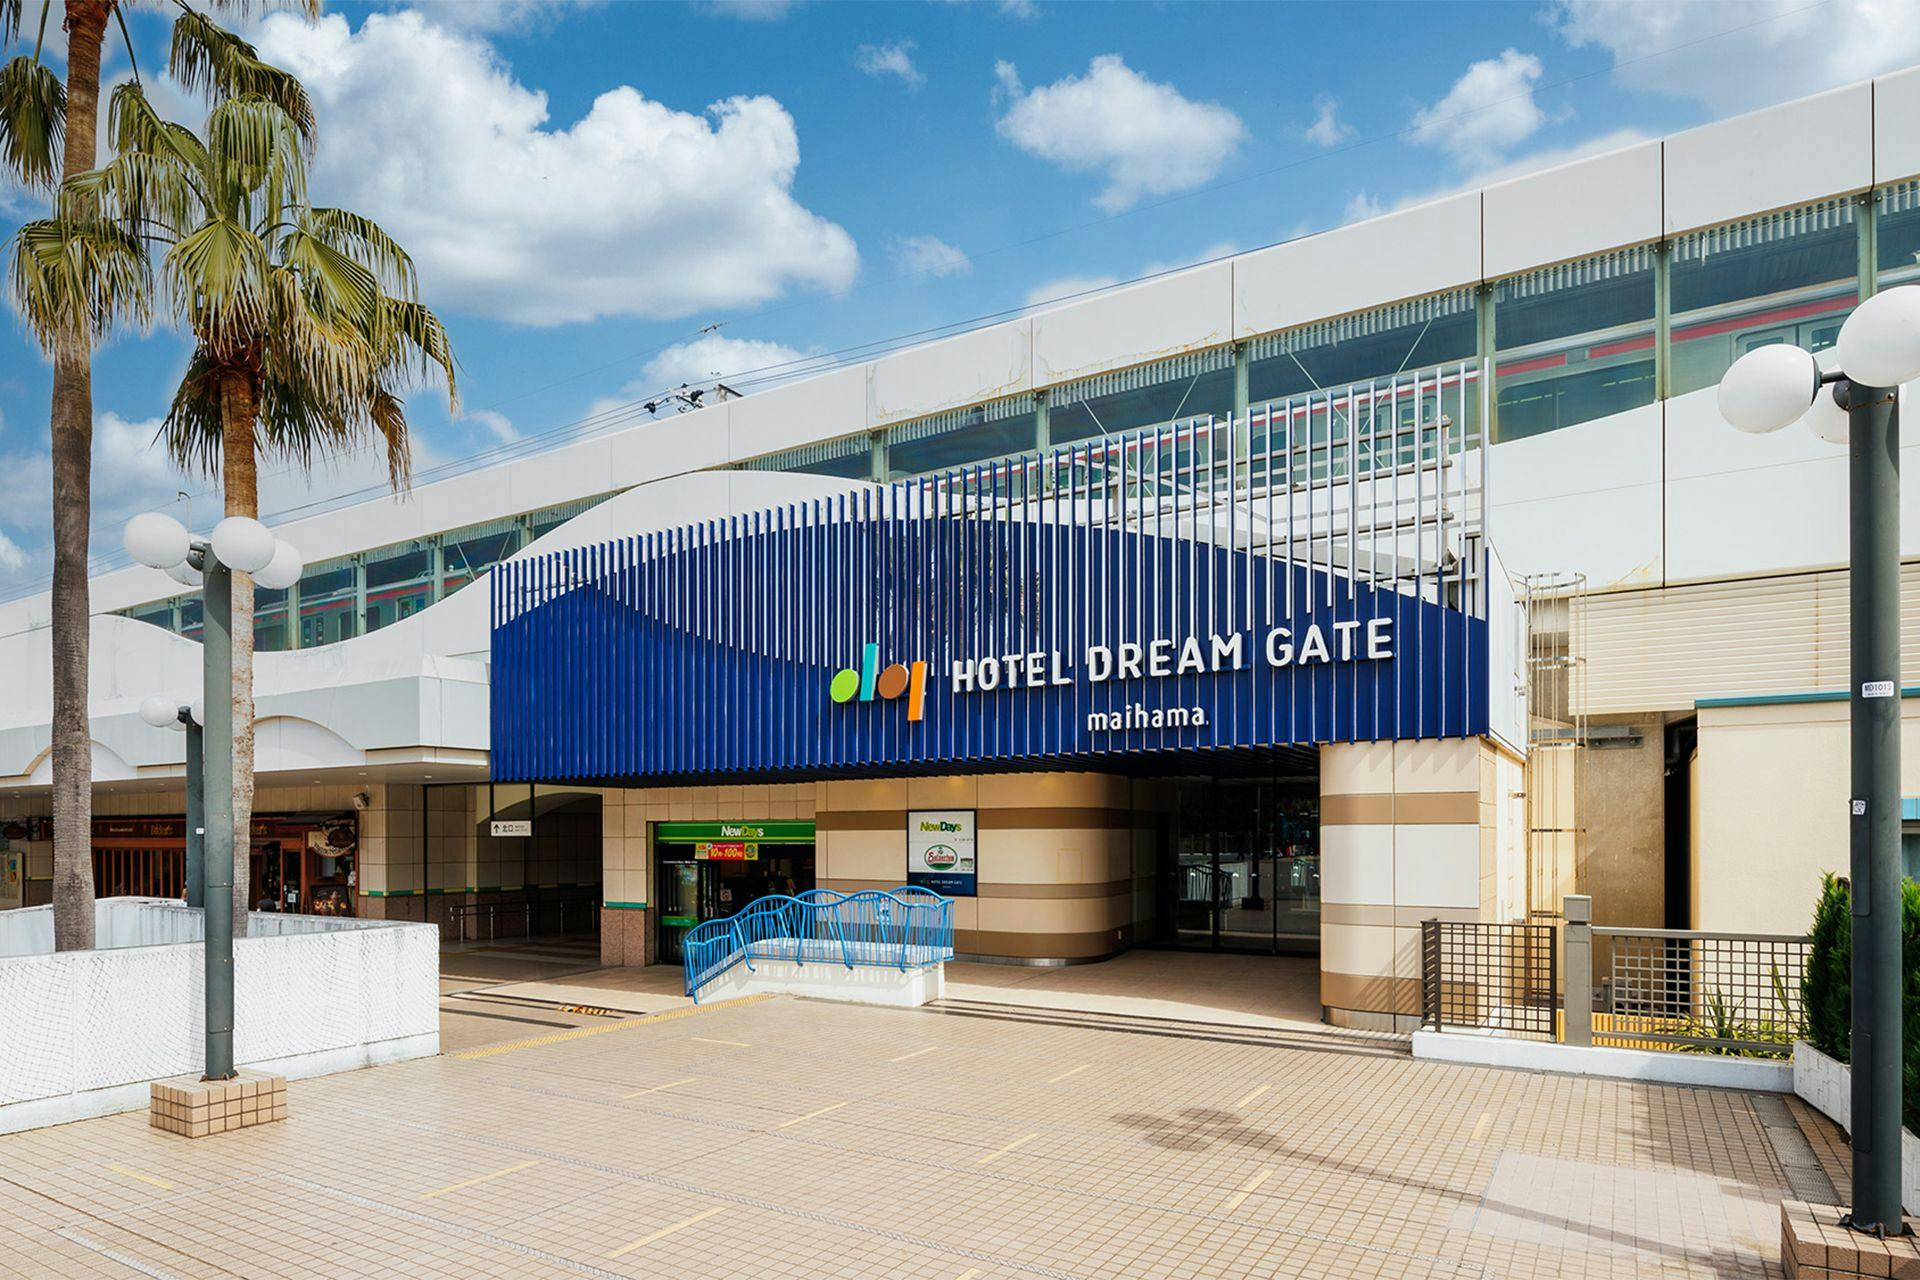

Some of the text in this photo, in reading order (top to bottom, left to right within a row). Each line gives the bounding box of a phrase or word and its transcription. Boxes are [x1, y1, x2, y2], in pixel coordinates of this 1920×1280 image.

[953, 617, 1394, 694] HOTEL DREAM GATE
[1087, 702, 1206, 732] maihama
[721, 825, 764, 838] NewDays
[920, 821, 962, 833] NewDays
